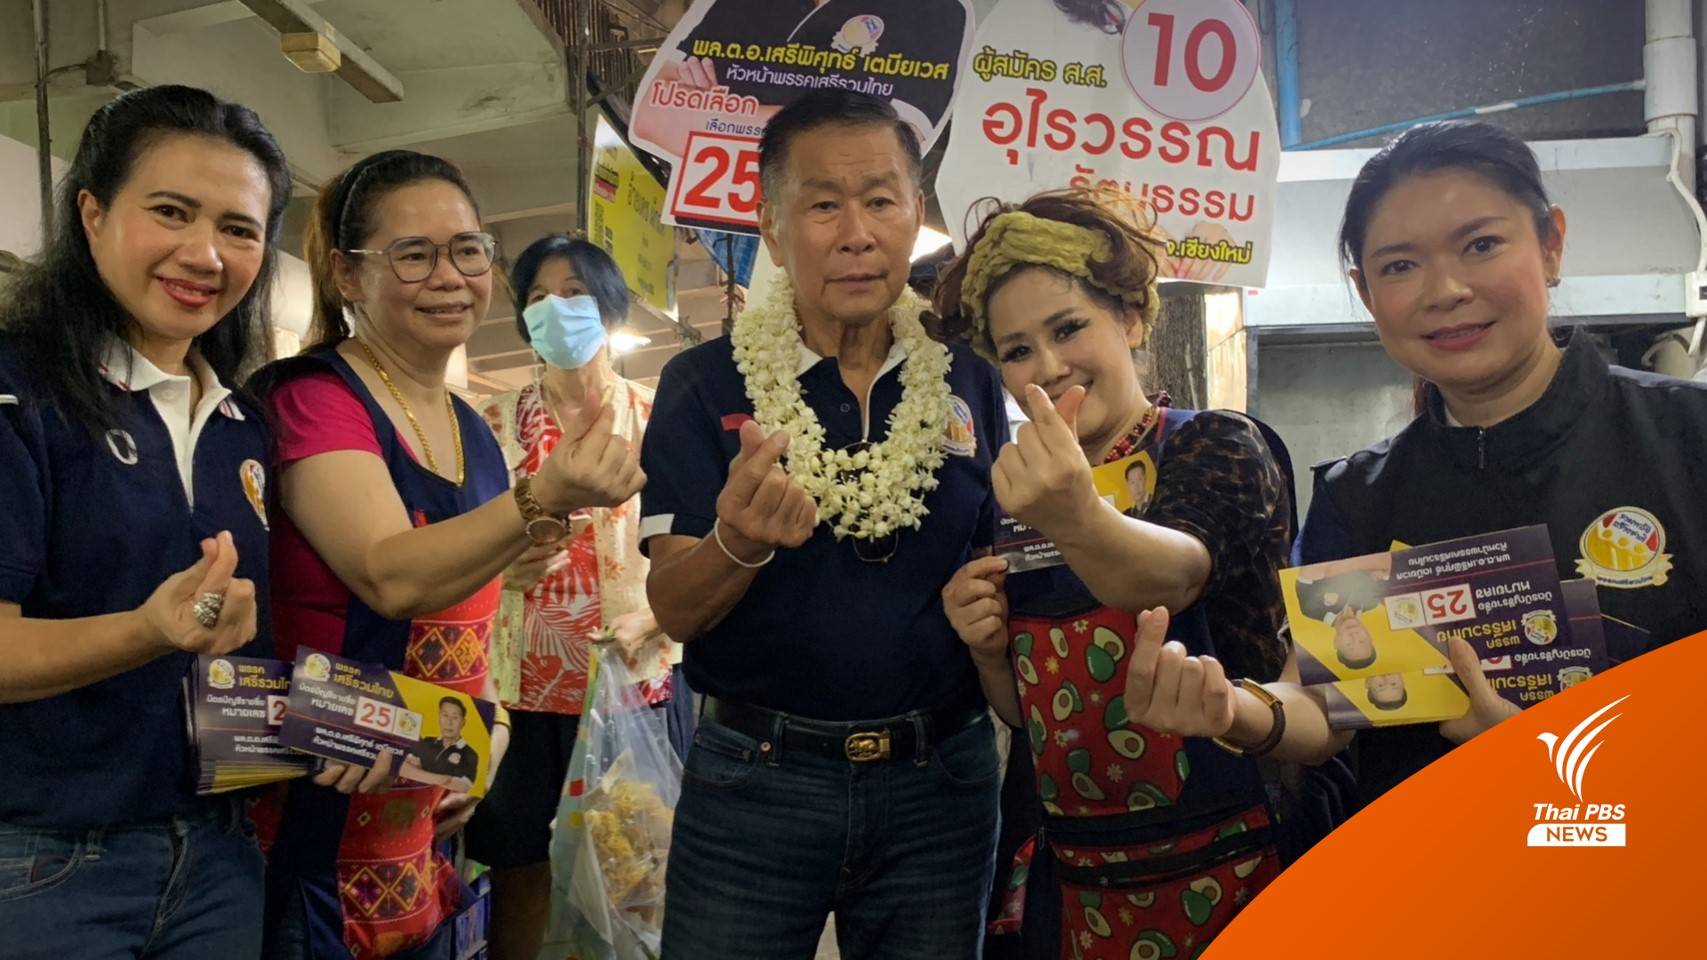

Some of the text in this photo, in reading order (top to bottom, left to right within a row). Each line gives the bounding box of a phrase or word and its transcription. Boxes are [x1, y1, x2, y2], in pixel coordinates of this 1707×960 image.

[693, 38, 950, 80] พล.ต.อ.เสรีพิศุทธ์ เตมียเวส
[973, 45, 1108, 88] ผู้สมัคร ส.ส.
[1148, 12, 1237, 93] 10
[726, 64, 893, 97] หัวหน้าพรรคเสรีรวมไทย
[651, 81, 758, 115] โปรดเลือก
[982, 88, 1260, 172] อุไรวรรณ
[684, 146, 764, 213] 25
[1427, 590, 1468, 618] 25
[1475, 580, 1531, 599] หมายเลข
[1478, 591, 1552, 614] บัตรบัญชีรายชื่อ
[1486, 635, 1520, 648] พรรค
[1514, 648, 1591, 666] บัตรบัญชีรายชื่อ
[334, 673, 394, 698] เสรีรวมไทย
[360, 703, 391, 727] 25
